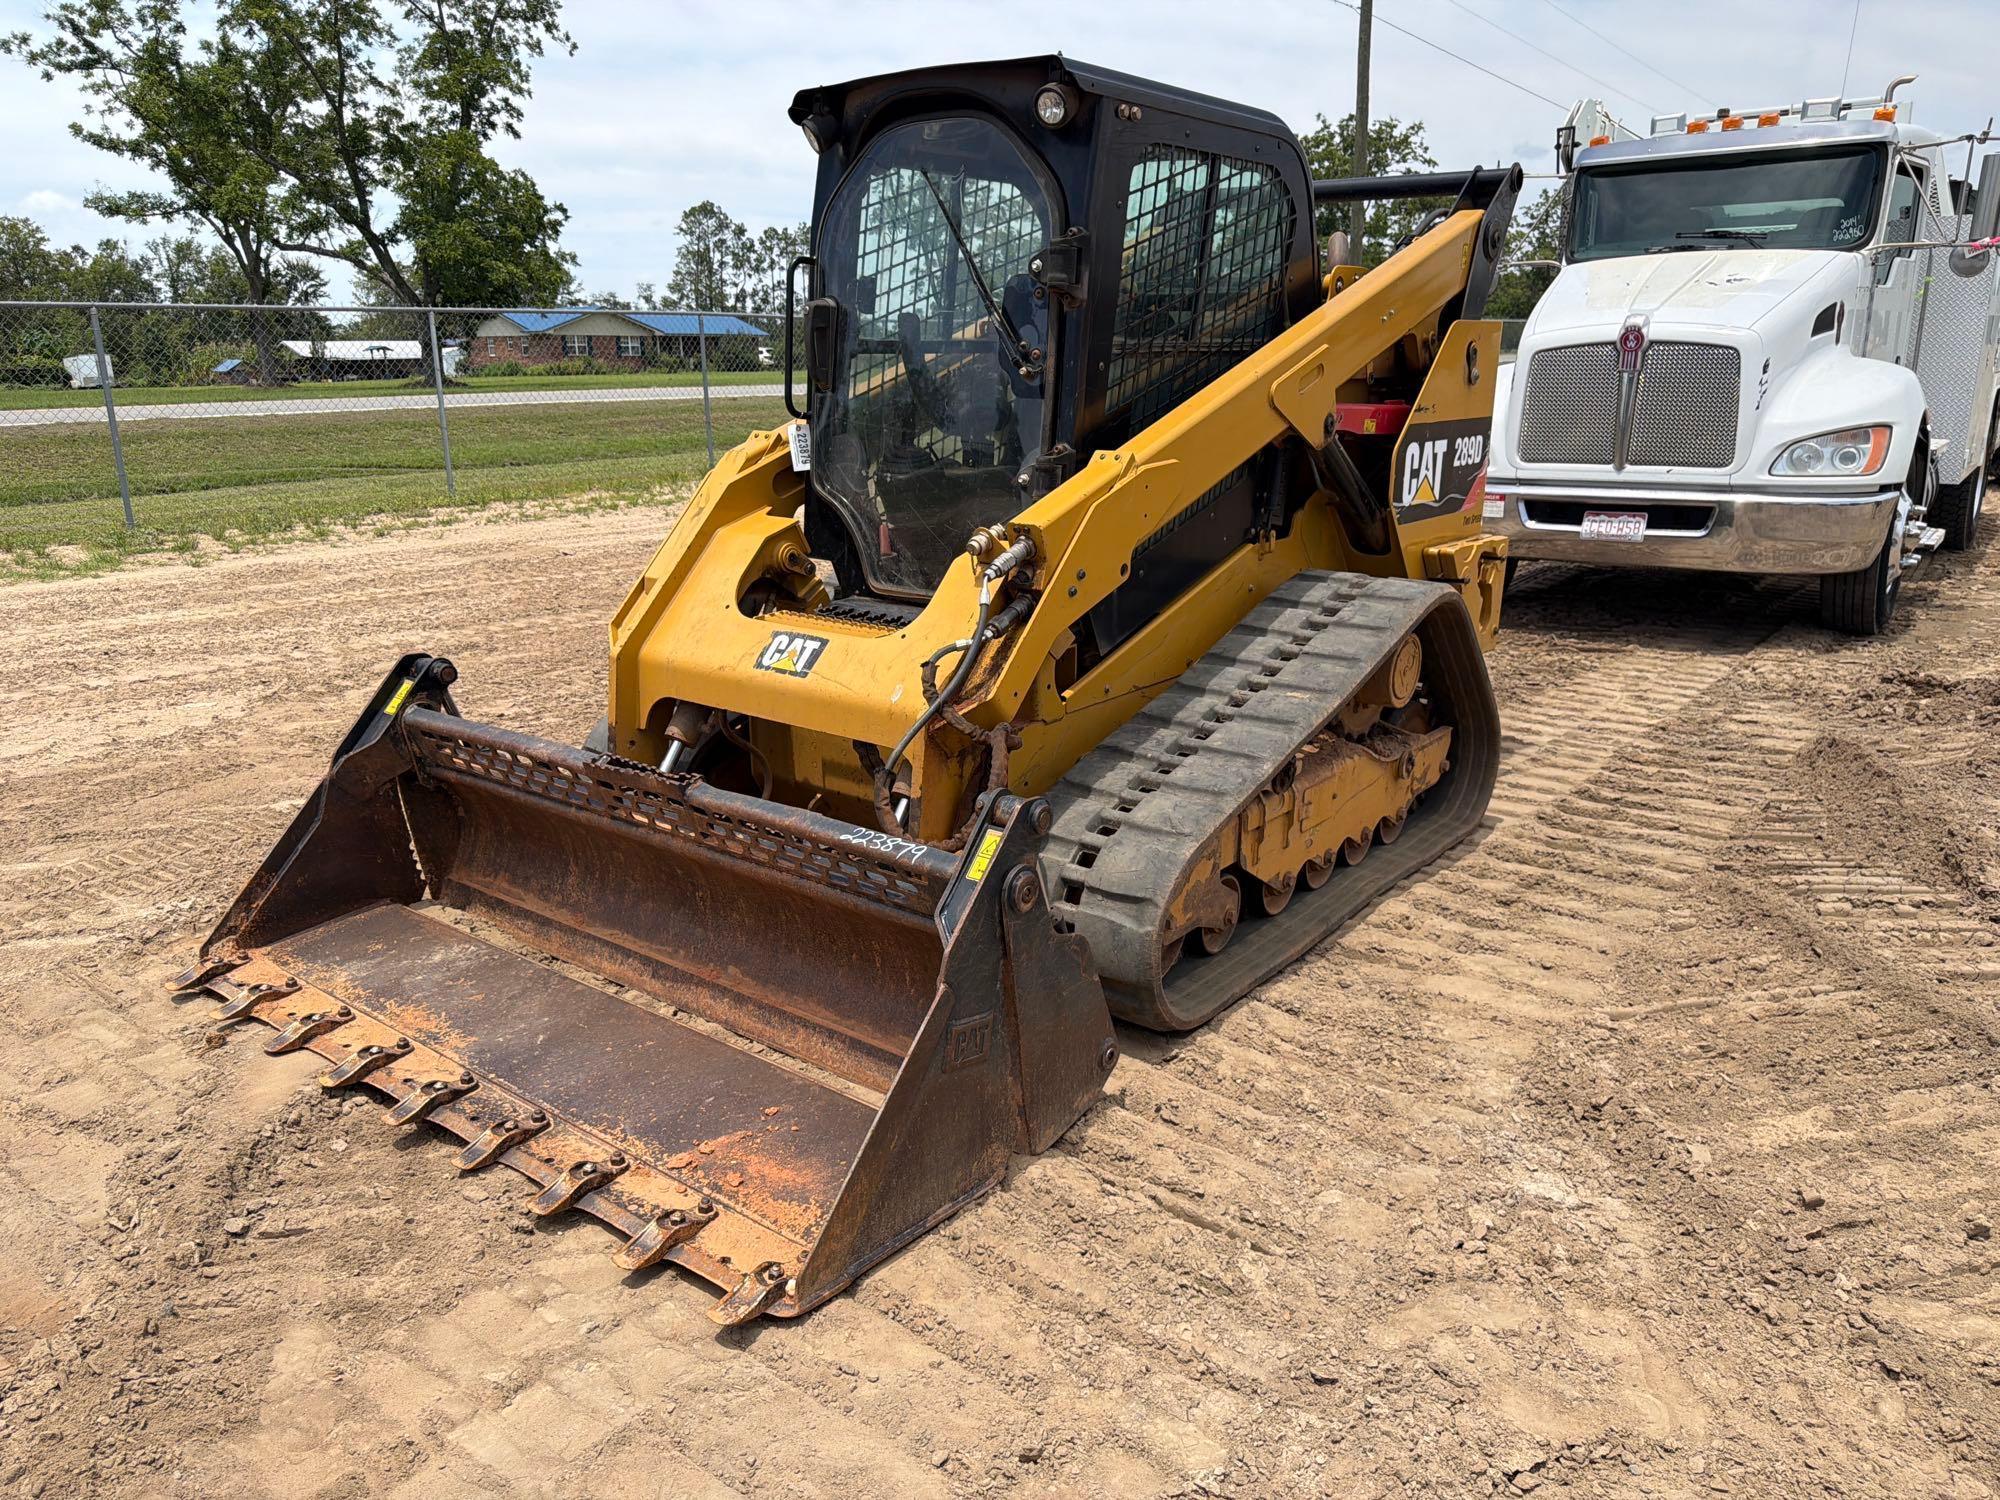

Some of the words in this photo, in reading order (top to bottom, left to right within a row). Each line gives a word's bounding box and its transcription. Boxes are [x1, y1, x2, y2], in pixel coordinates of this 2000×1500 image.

[797, 432, 812, 465] 223879
[1402, 439, 1448, 507] CAT
[1453, 434, 1484, 467] 289D
[762, 634, 821, 673] CAT
[839, 827, 928, 864] 223879
